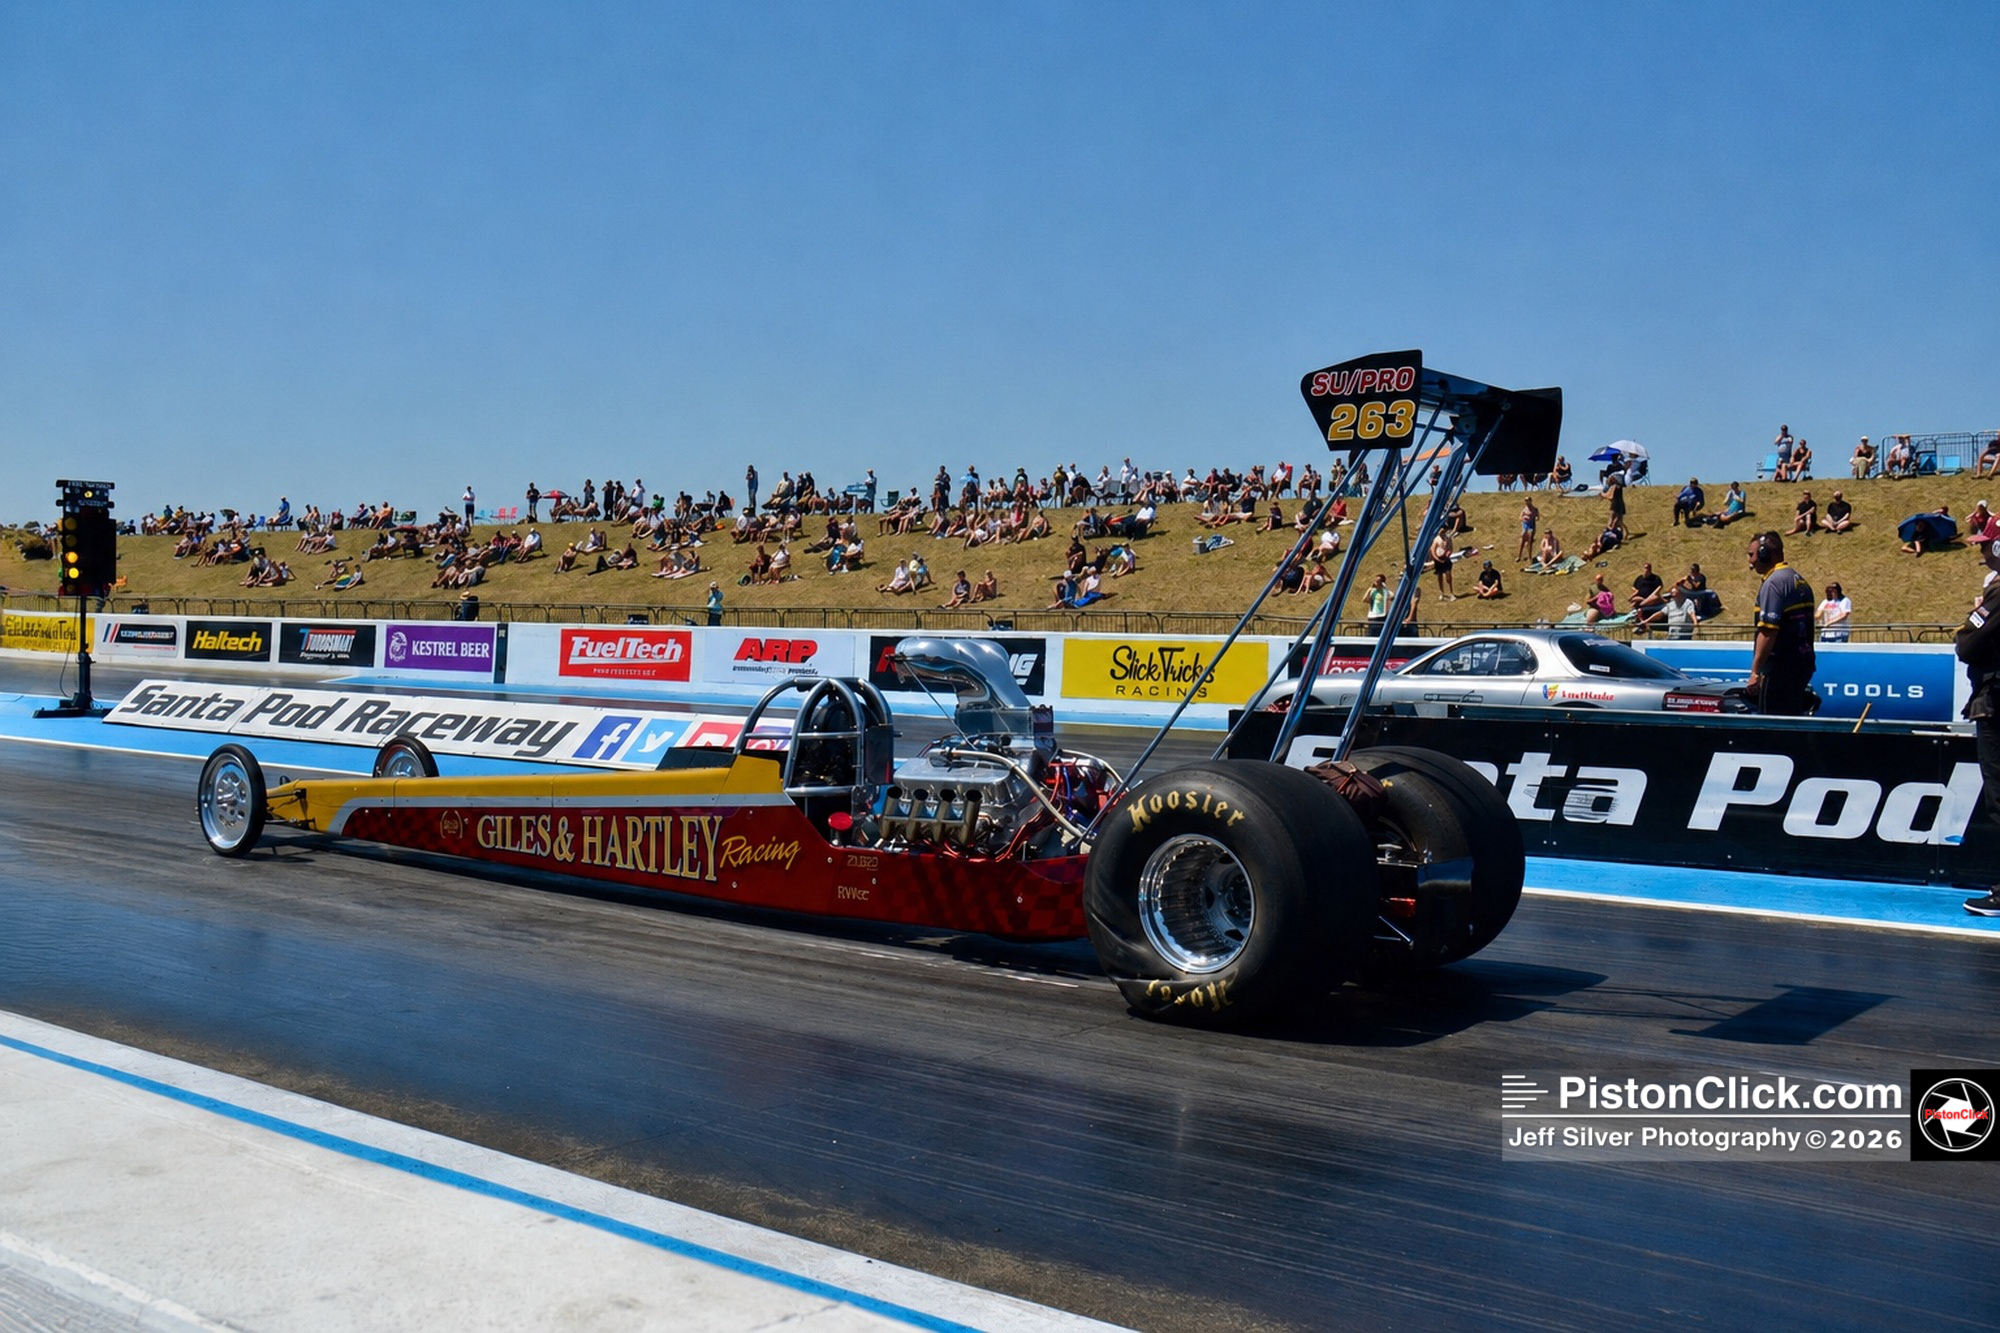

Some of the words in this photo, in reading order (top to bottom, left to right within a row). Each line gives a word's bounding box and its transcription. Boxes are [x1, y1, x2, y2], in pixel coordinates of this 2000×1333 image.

[1311, 366, 1416, 397] SU/PRO
[1327, 399, 1416, 441] 263
[192, 630, 263, 652] Haltech
[411, 640, 459, 657] KESTREL
[460, 642, 490, 658] BEER
[567, 636, 683, 662] FuelTech
[733, 637, 818, 664] ARP
[1823, 682, 1925, 699] TOOLS
[118, 684, 245, 722] Santa
[240, 692, 350, 730] Pod
[334, 698, 581, 758] Raceway
[1127, 784, 1246, 833] Hoosier
[1687, 750, 1985, 846] Pod
[476, 814, 552, 857] GILES
[581, 814, 723, 882] HARTLEY
[719, 834, 802, 871] Racing
